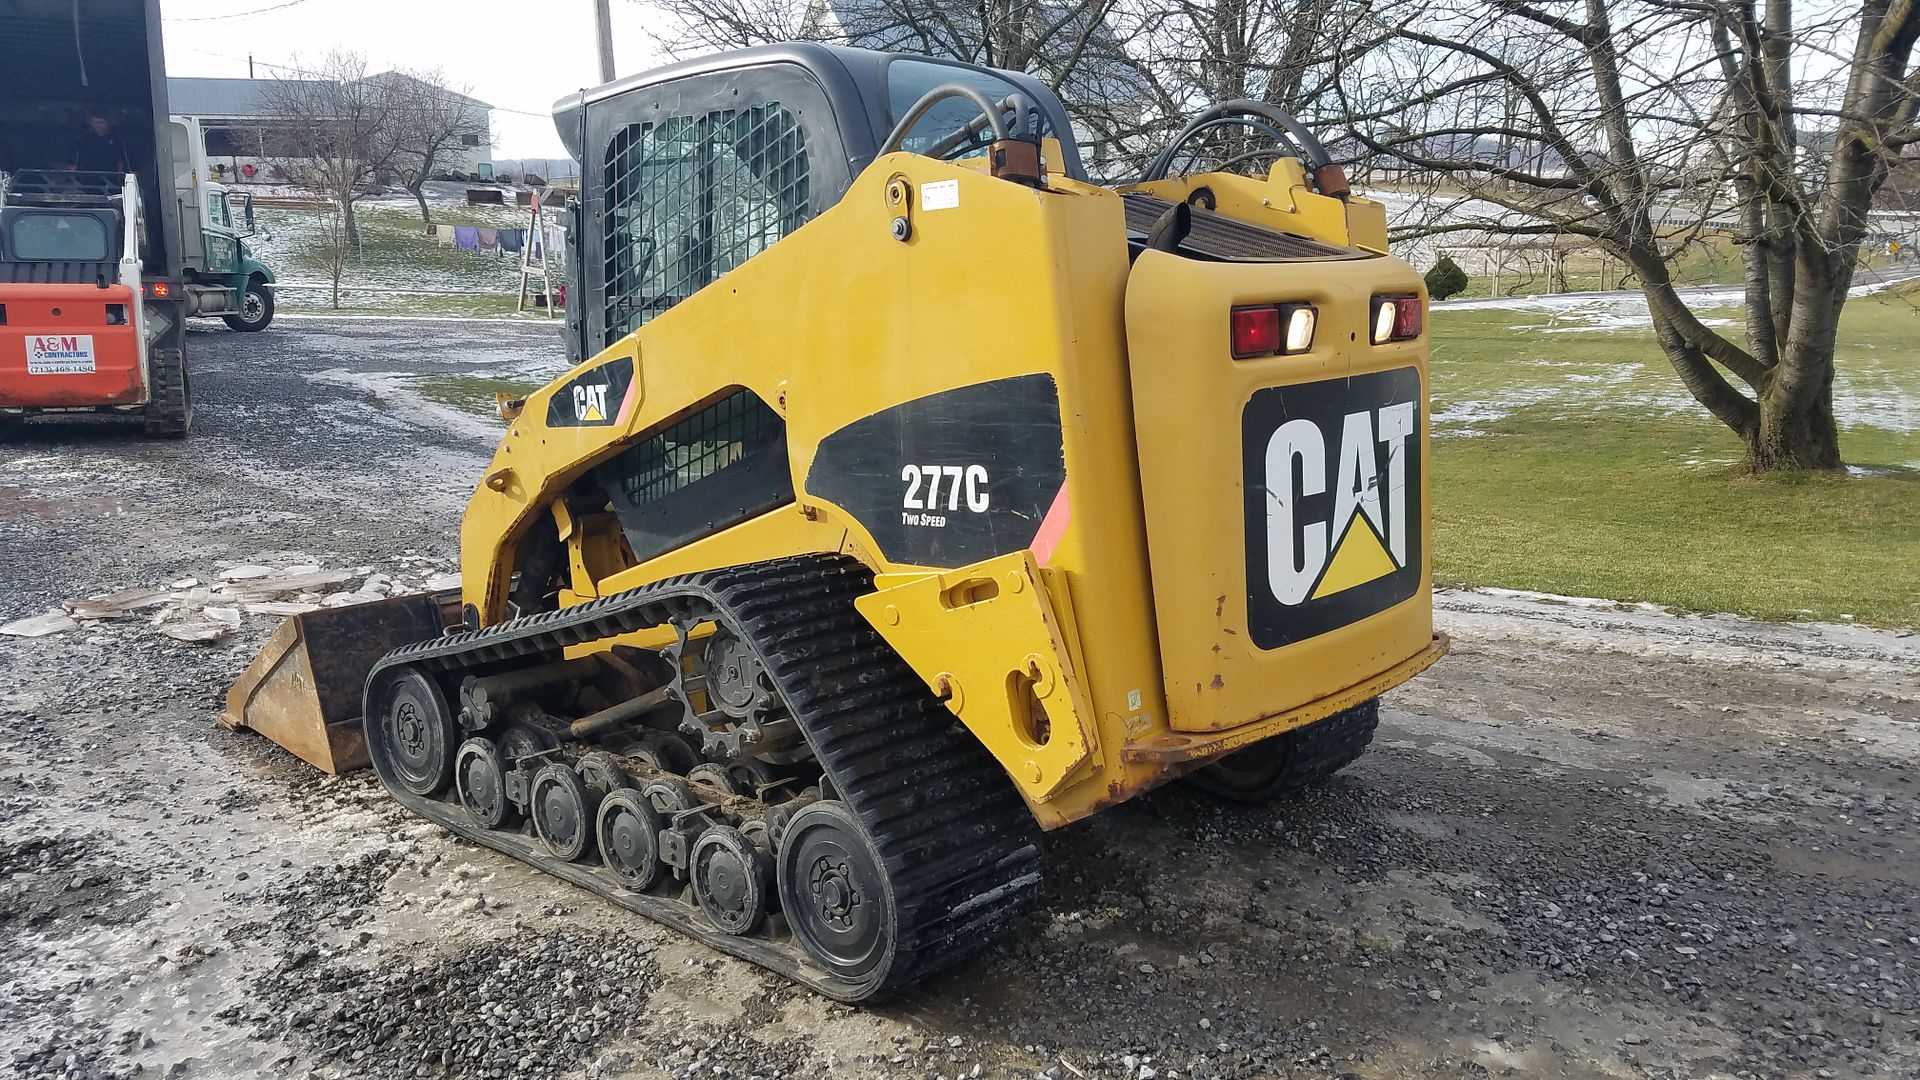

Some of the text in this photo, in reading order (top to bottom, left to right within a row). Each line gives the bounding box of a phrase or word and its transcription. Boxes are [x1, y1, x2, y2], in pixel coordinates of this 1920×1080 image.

[33, 336, 78, 352] A&M
[44, 351, 88, 359] CONTRACTORS
[572, 384, 607, 421] CAT
[901, 464, 990, 513] 277C
[1265, 401, 1414, 606] CAT
